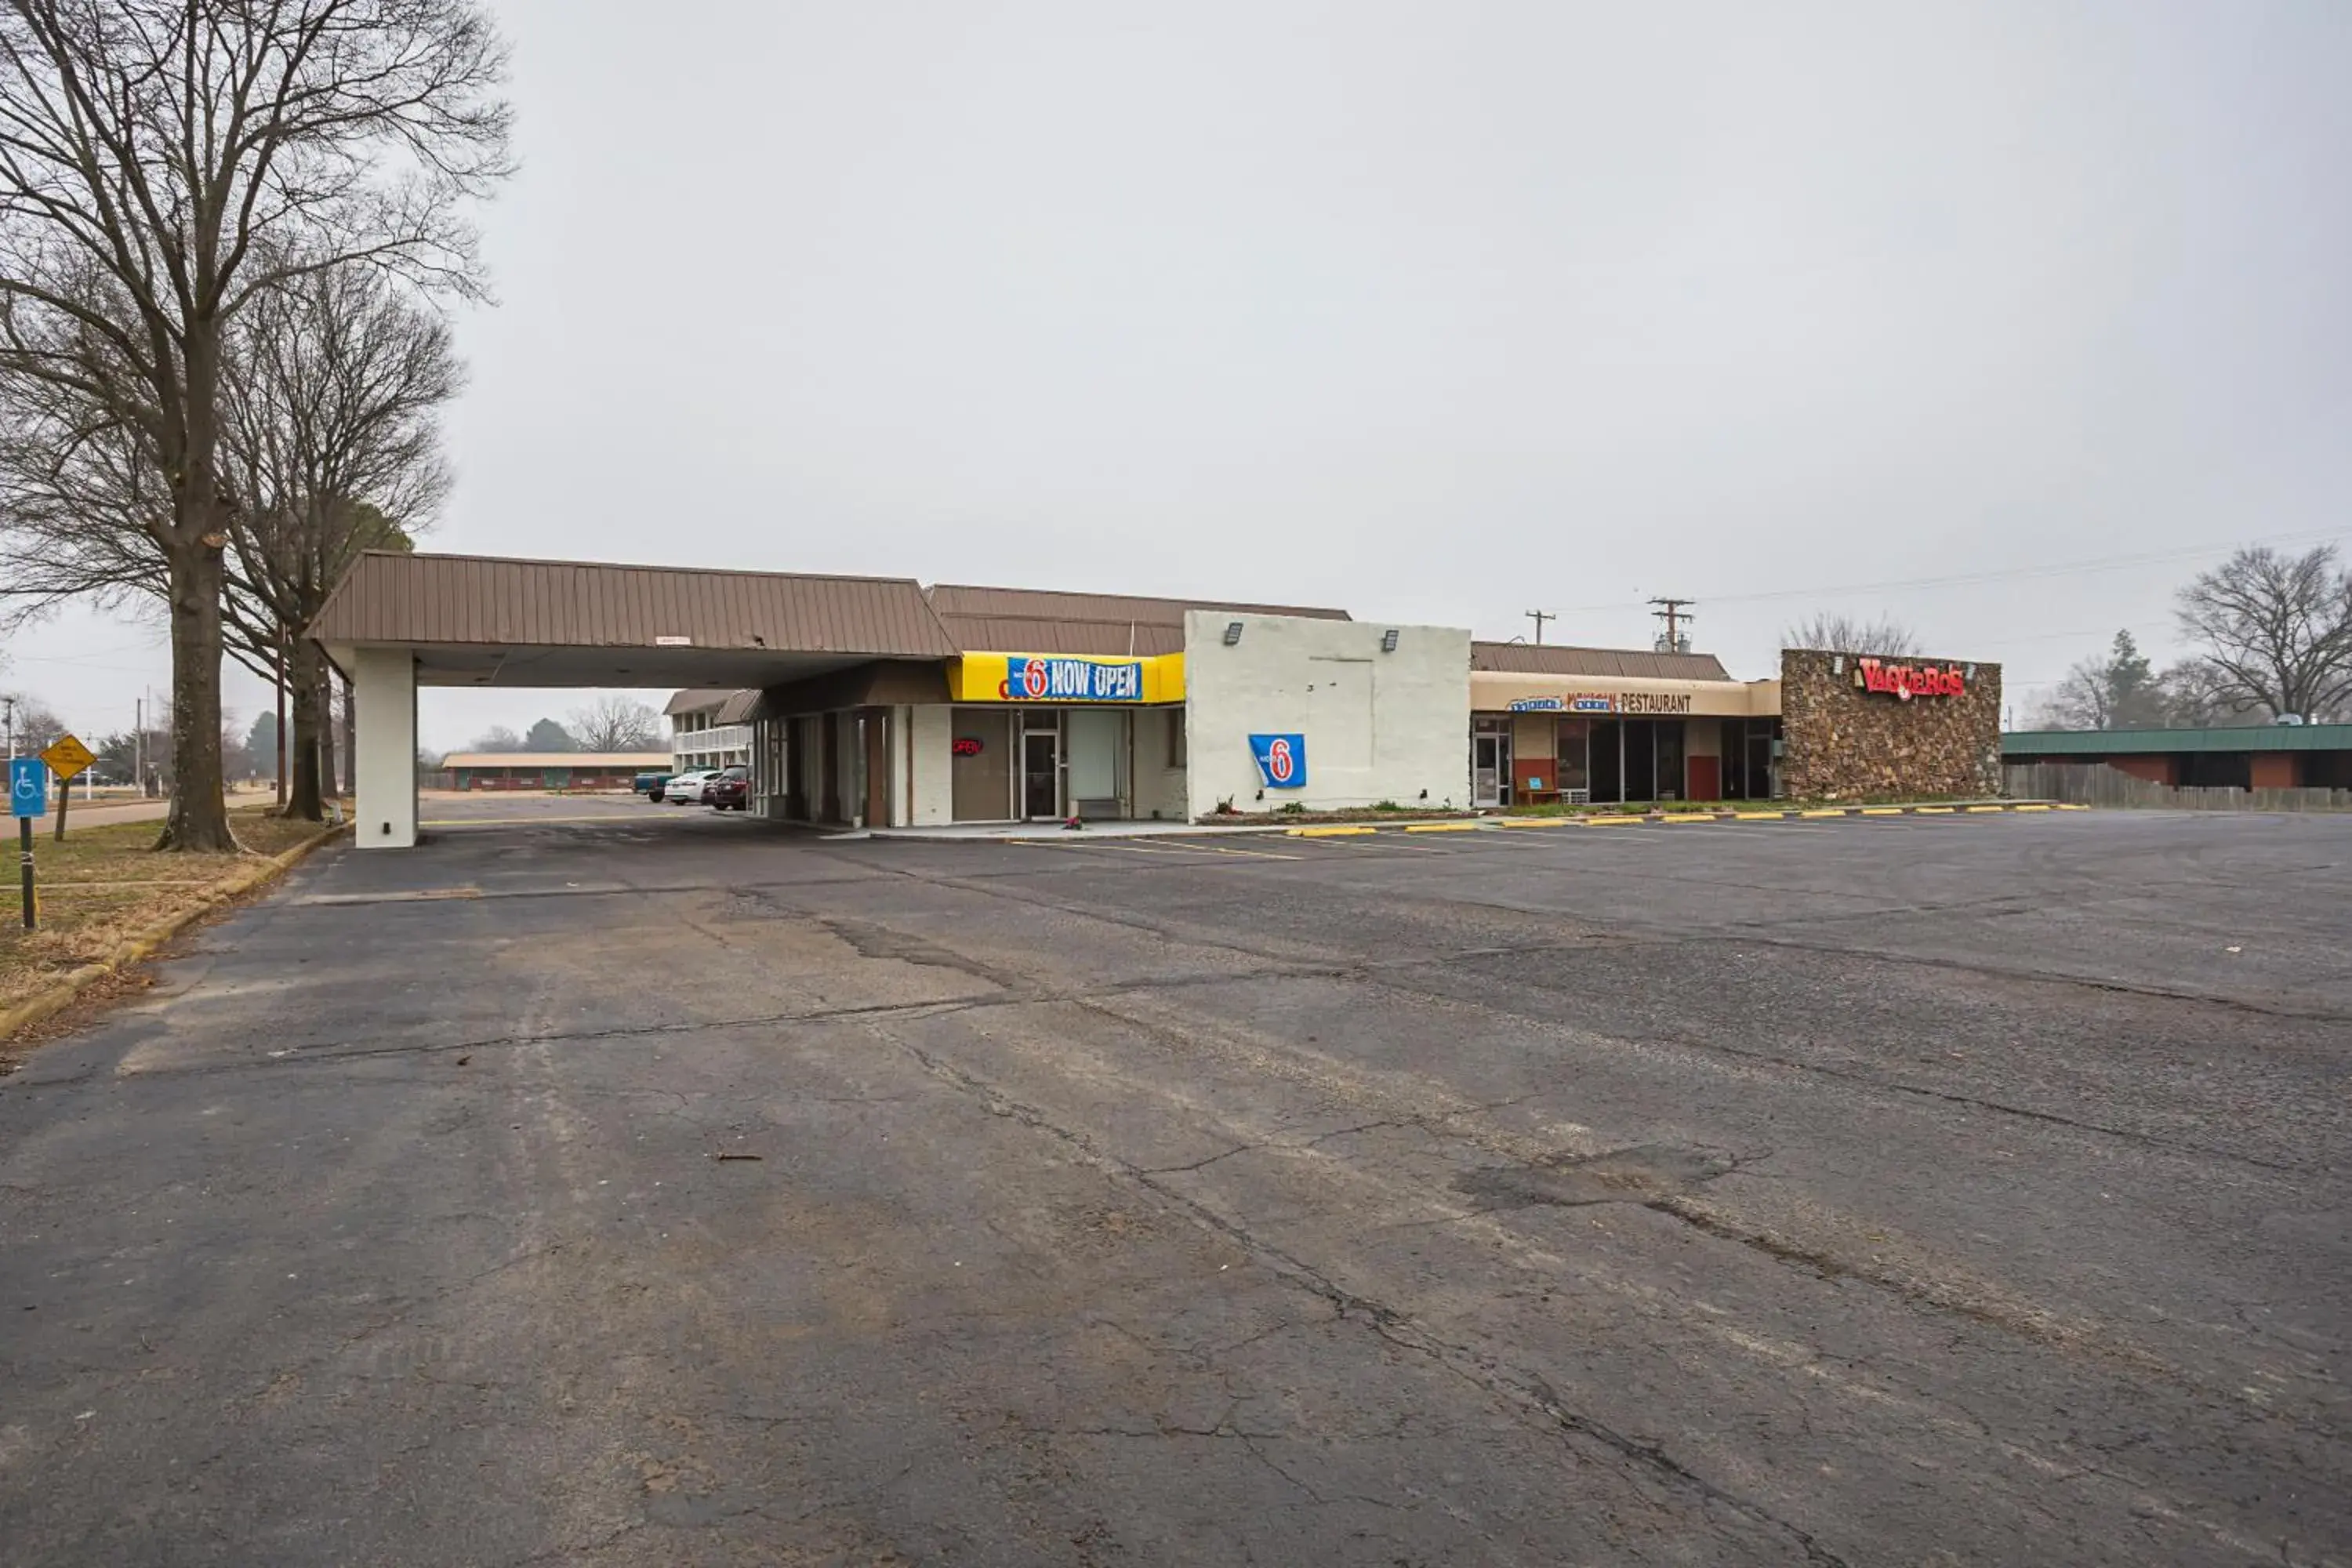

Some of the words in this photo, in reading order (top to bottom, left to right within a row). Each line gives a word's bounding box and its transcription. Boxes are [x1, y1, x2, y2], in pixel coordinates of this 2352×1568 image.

[1024, 659, 1047, 698] 6
[1051, 660, 1089, 695] NOW
[1094, 665, 1137, 696] OPEN
[1621, 692, 1691, 712] RESTAURANT
[1270, 739, 1293, 782] 6
